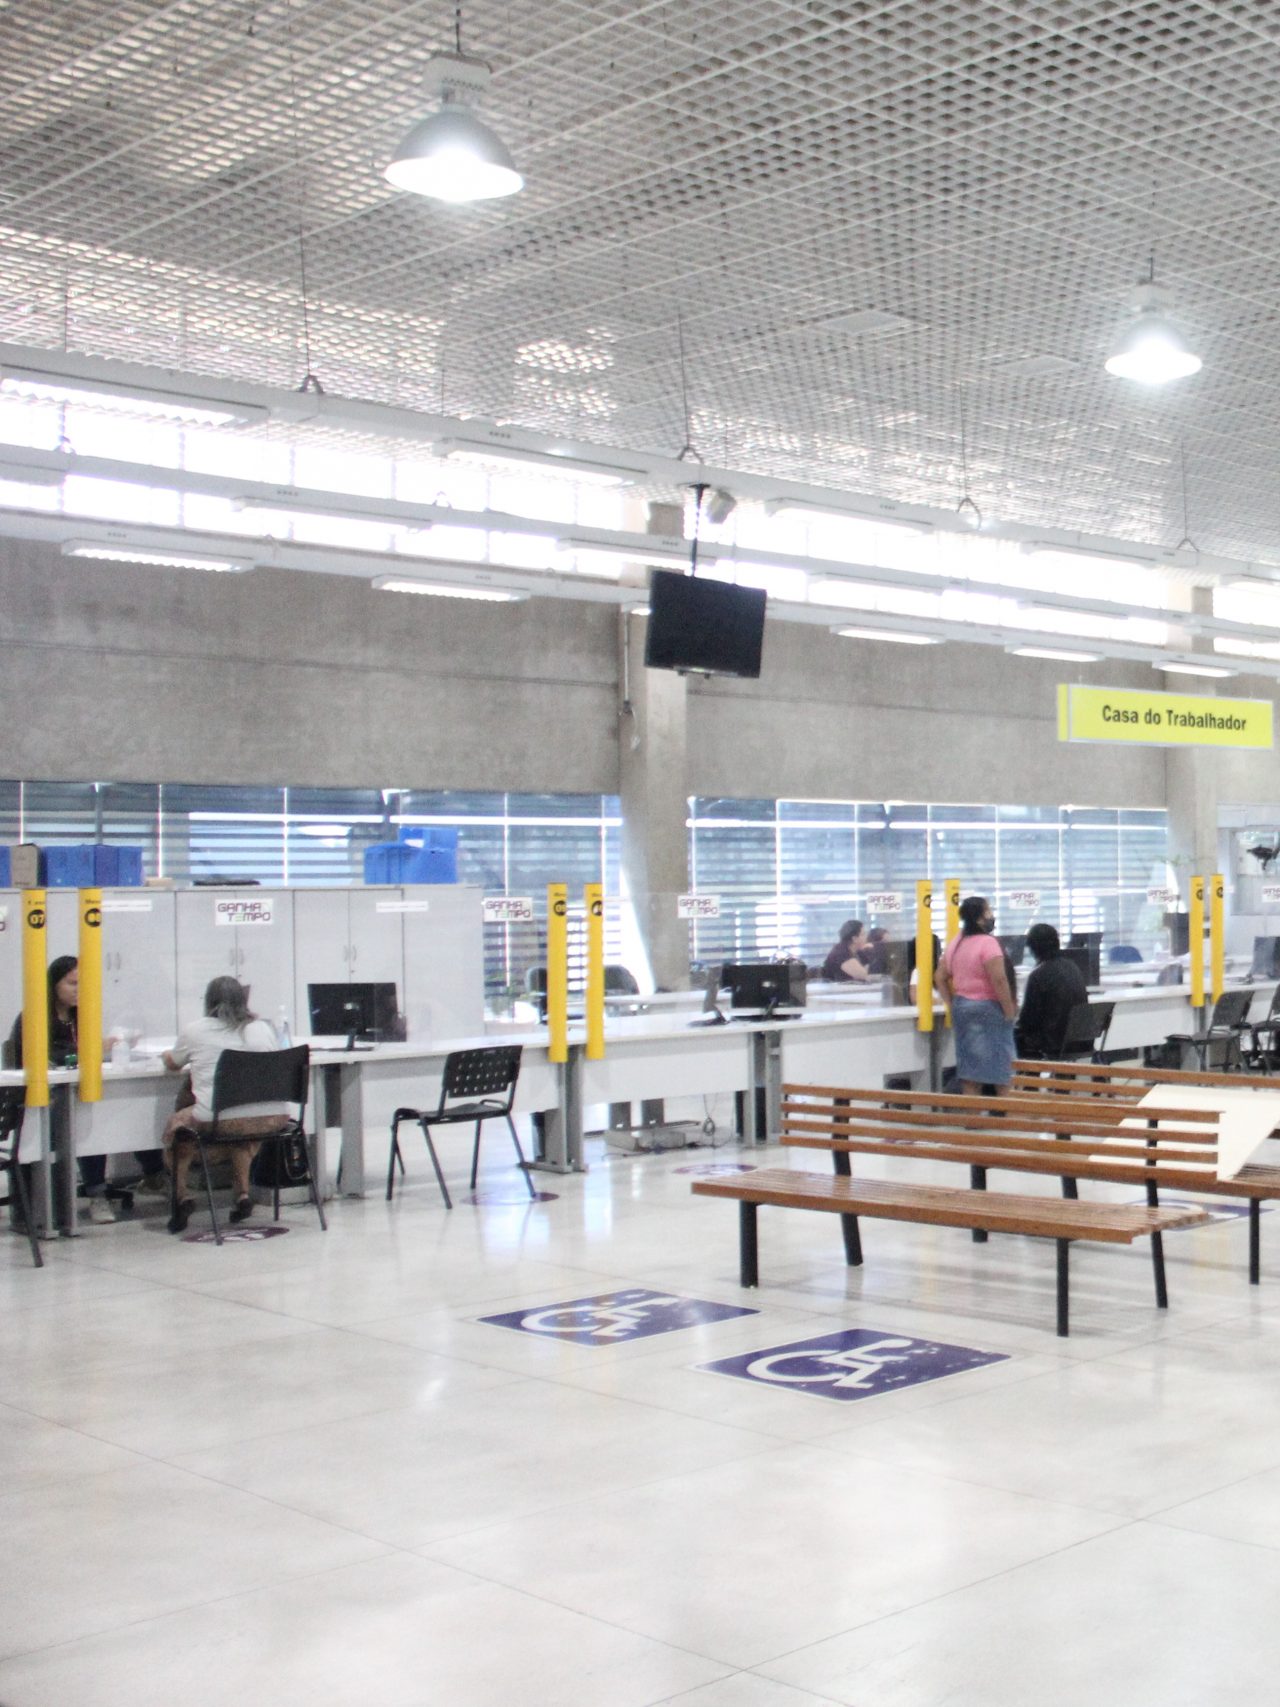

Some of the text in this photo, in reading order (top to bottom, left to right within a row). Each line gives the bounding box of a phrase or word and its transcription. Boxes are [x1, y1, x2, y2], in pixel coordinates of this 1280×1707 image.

[1102, 704, 1247, 730] Casa do Trabalhador
[217, 902, 261, 913] GANHA
[486, 900, 522, 910] GANHA
[227, 911, 271, 922] TEMPO
